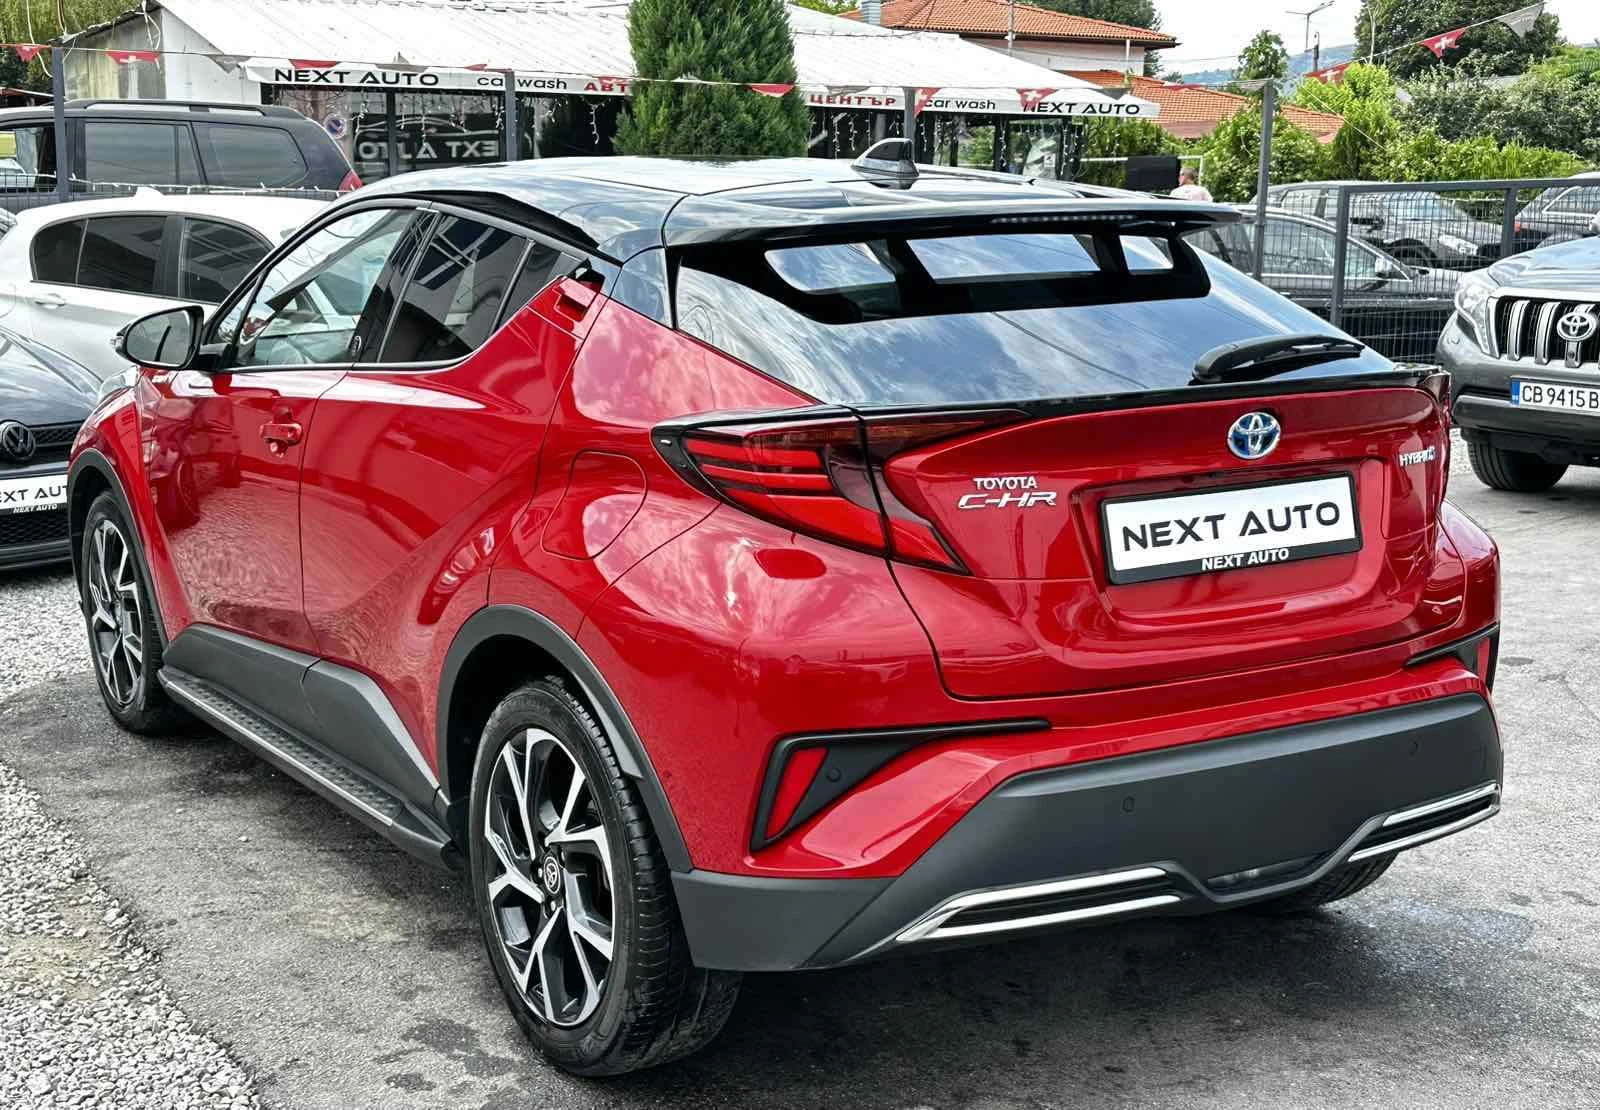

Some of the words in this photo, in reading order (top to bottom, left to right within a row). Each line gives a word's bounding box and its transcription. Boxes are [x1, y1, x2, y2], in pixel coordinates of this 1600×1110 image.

[275, 69, 350, 83] NEXT
[359, 71, 438, 86] AUTO
[477, 77, 504, 87] ca
[517, 78, 568, 90] wash
[584, 82, 629, 93] АВТ
[810, 94, 897, 106] ЦЕНТЪР
[955, 99, 996, 110] wash
[1082, 103, 1140, 115] AUTO
[1522, 385, 1543, 403] CB
[1547, 387, 1586, 408] 9415
[973, 476, 1037, 490] TOYOTA
[0, 488, 29, 503] XT
[958, 491, 1057, 509] C-HR
[36, 503, 57, 511] AUTO
[1122, 513, 1226, 552] NEXT
[1239, 501, 1340, 537] AUTO
[1201, 553, 1245, 571] NEXT
[1247, 548, 1289, 566] AUTO
